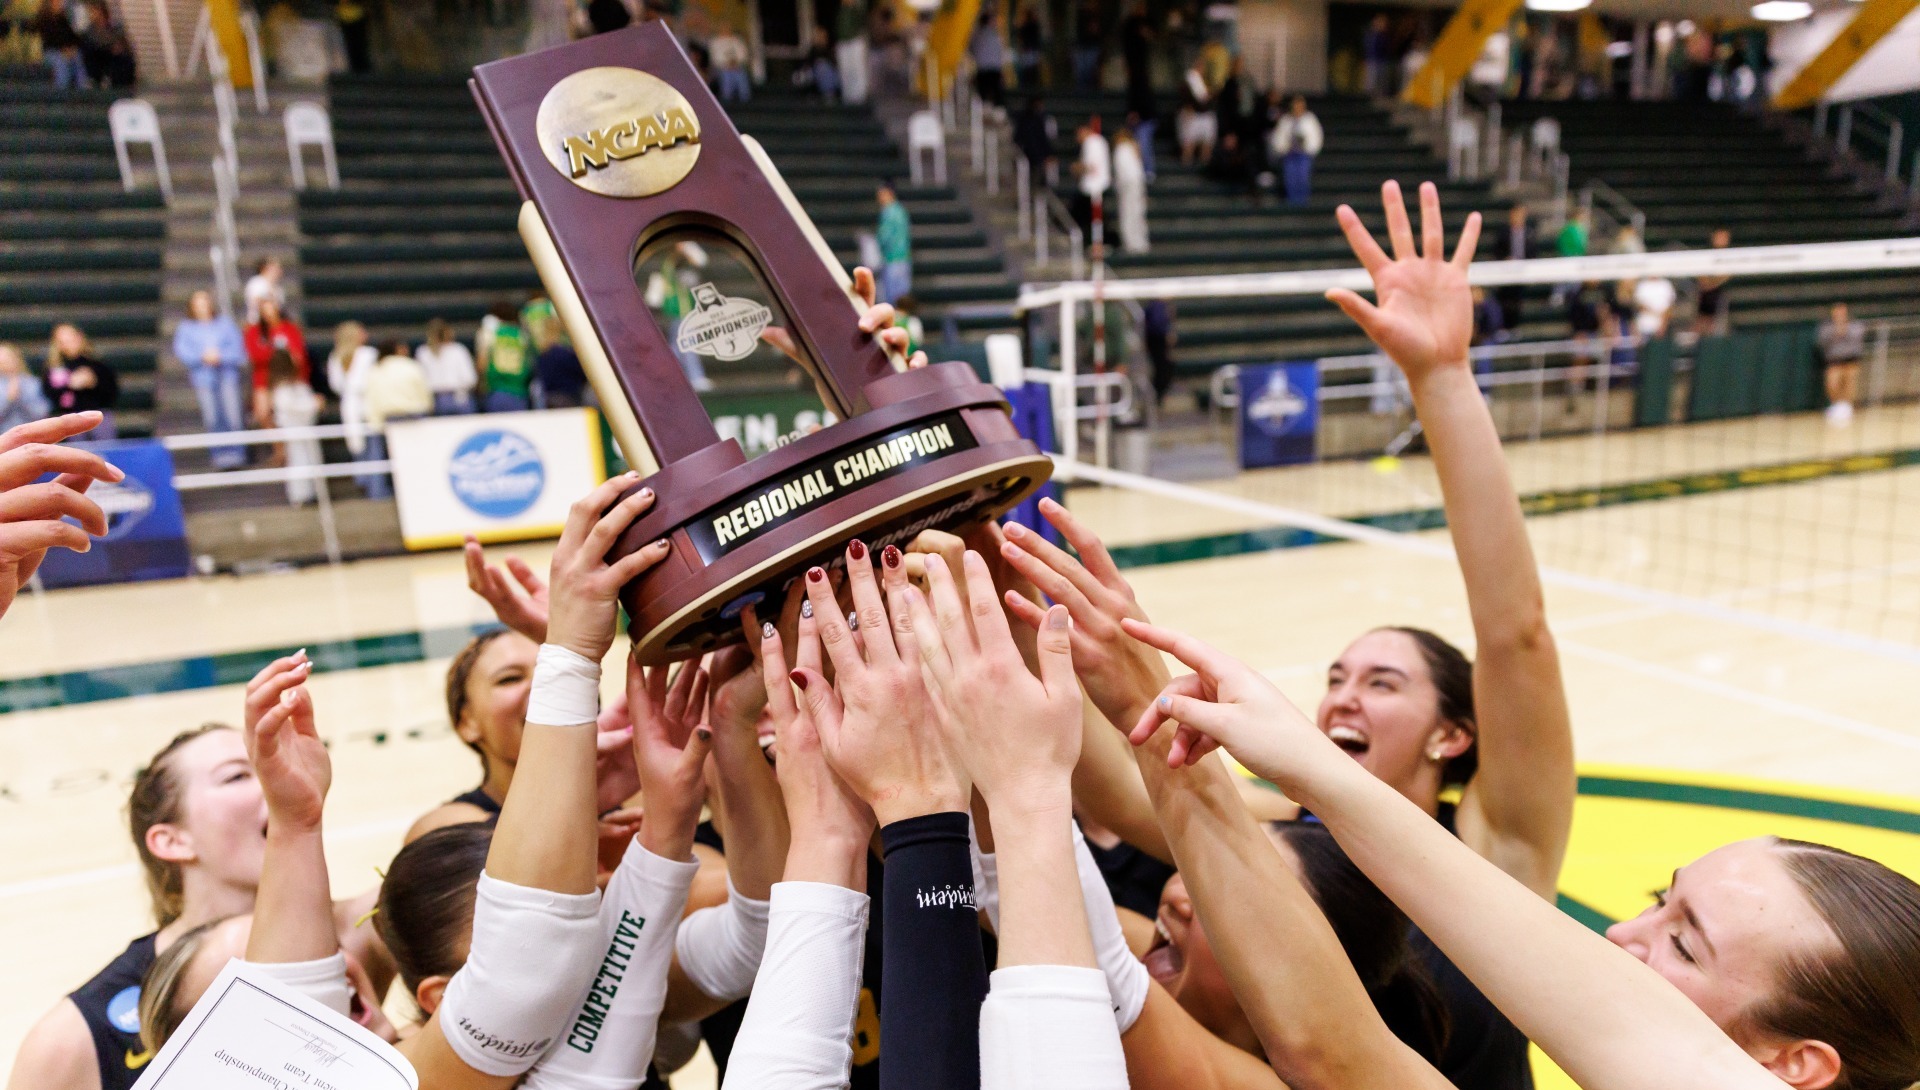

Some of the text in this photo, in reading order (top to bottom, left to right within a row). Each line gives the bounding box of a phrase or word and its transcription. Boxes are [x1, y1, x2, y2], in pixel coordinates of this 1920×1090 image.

[563, 107, 699, 178] NCAA
[680, 309, 768, 350] CHAMPIONSHIP
[713, 468, 834, 547] REGIONAL
[833, 423, 955, 487] CHAMPION
[567, 909, 646, 1054] COMPETITIVE
[283, 1062, 312, 1084] Team
